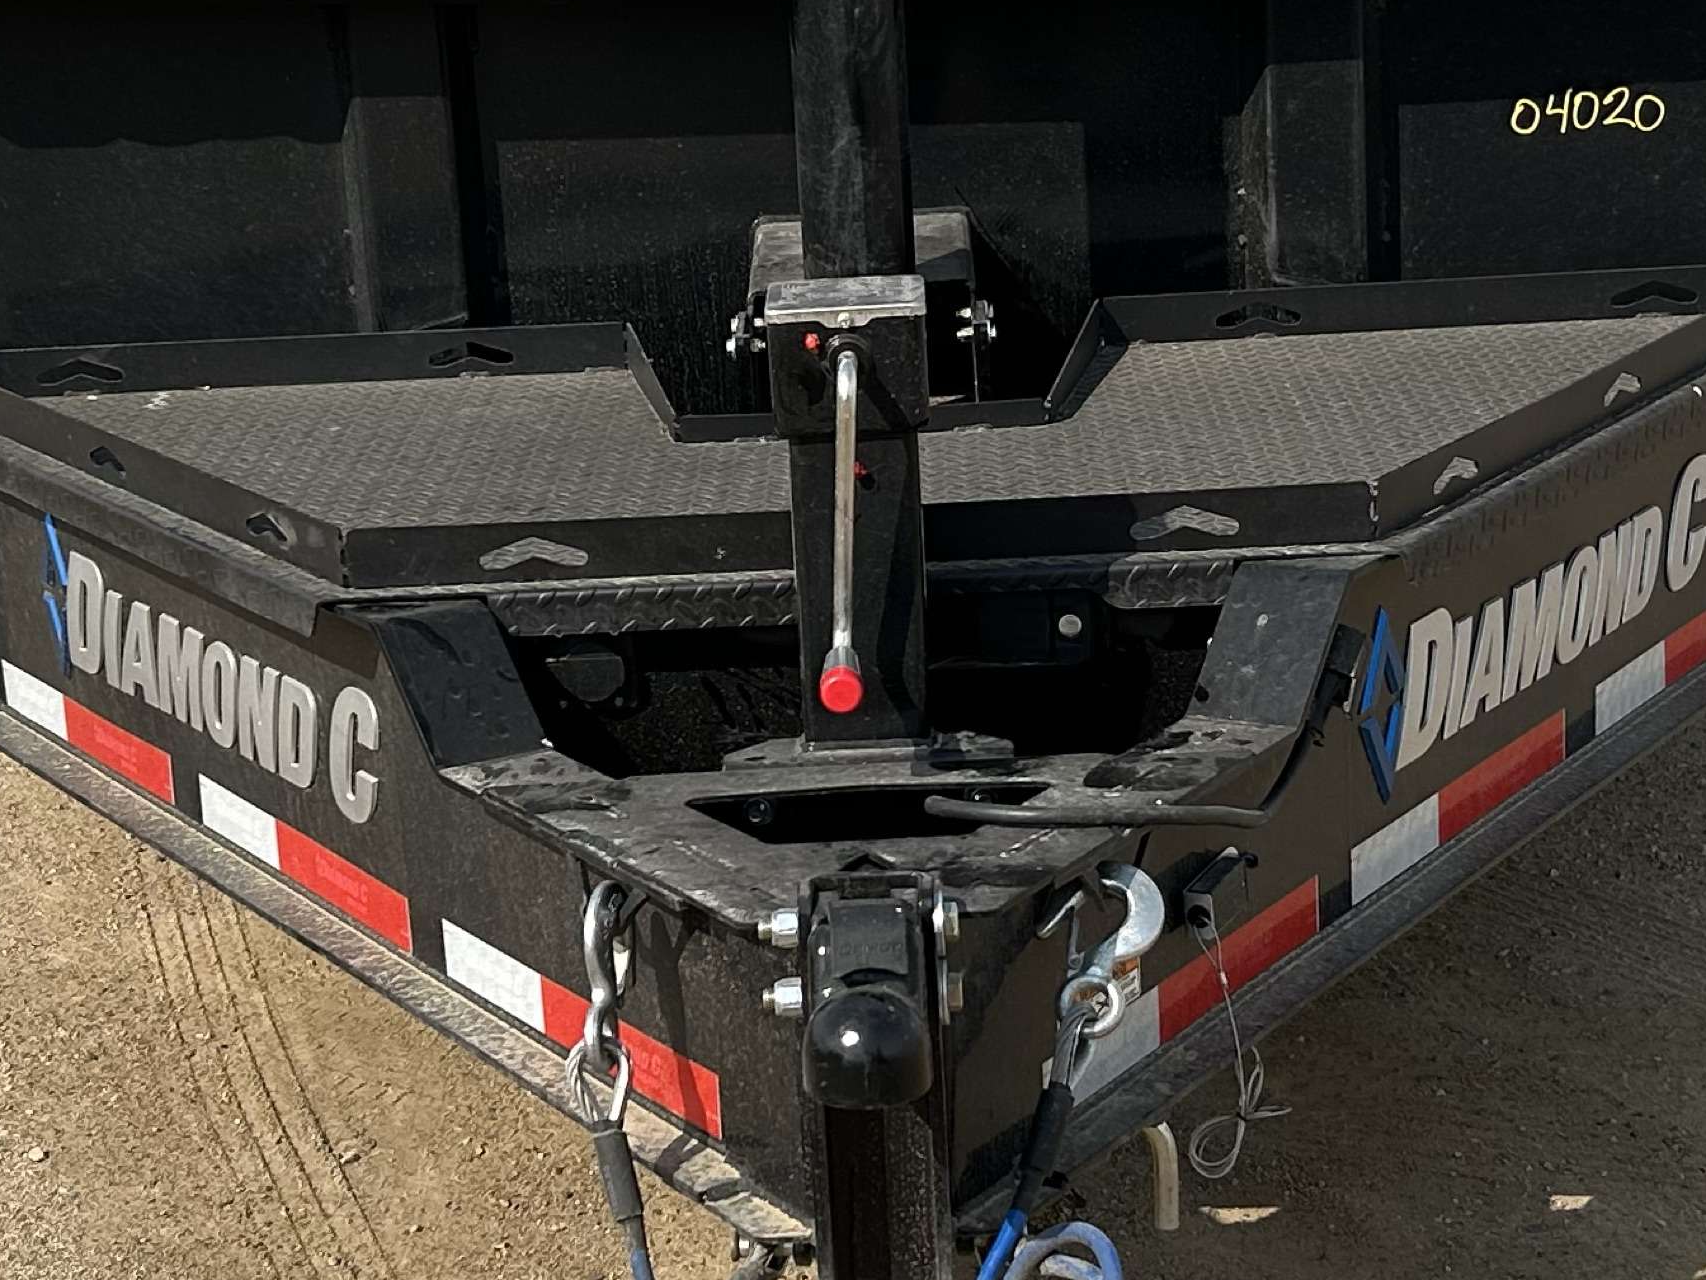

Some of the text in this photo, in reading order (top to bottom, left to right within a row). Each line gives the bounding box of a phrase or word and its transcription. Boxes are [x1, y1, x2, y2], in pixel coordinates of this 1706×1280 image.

[1510, 85, 1665, 134] 04020
[66, 550, 389, 824] DIAMOND C
[1395, 505, 1664, 772] DIAMOND
